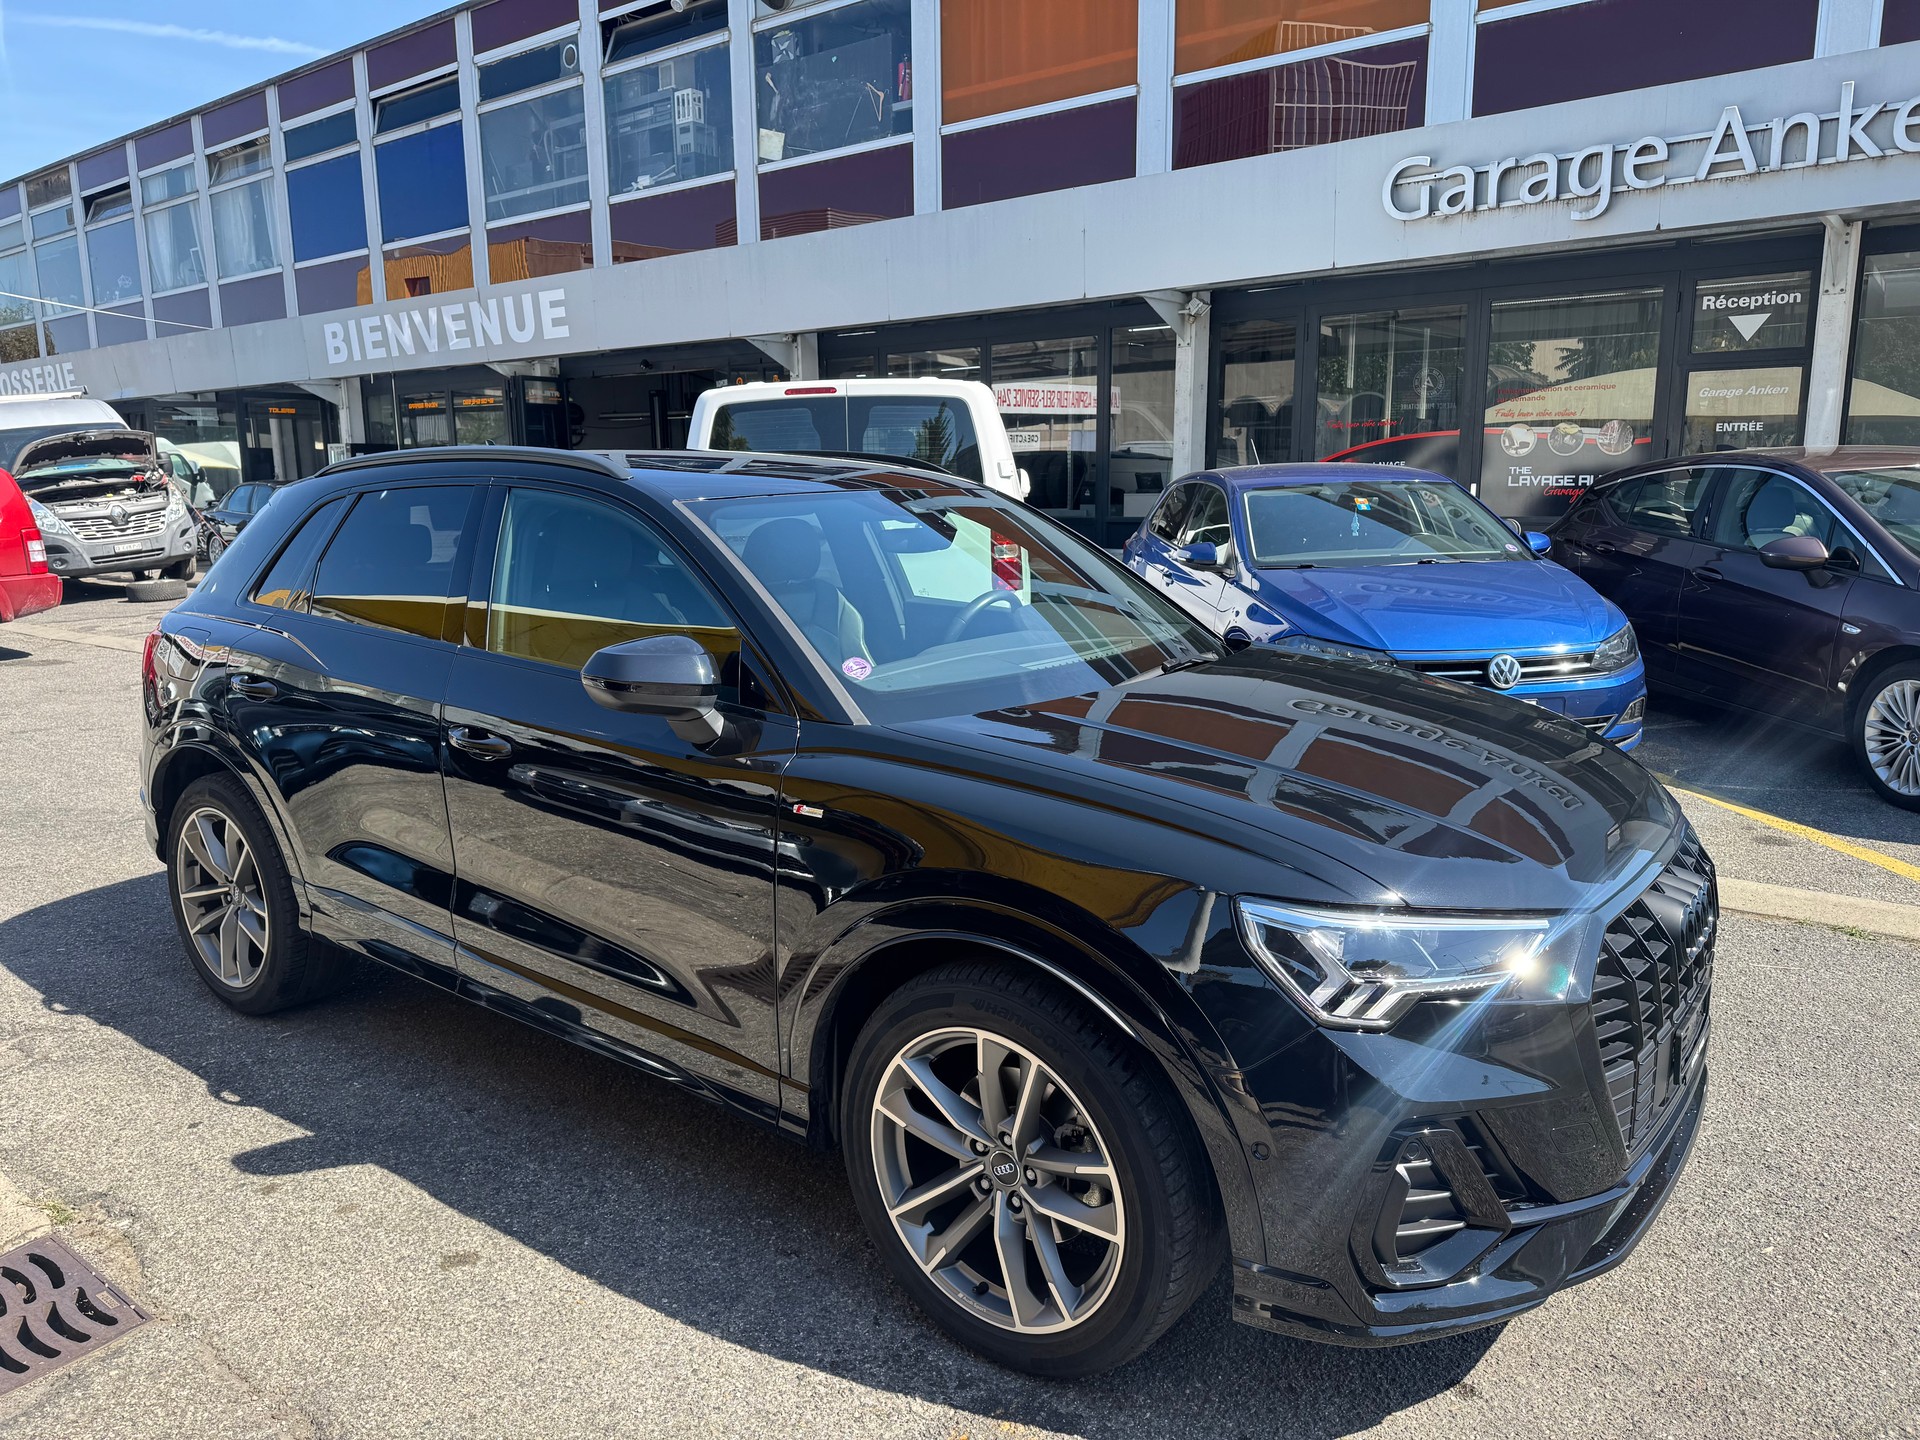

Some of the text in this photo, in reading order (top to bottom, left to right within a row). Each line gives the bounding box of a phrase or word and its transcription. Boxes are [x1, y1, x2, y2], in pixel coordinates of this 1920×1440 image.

[1381, 135, 1669, 221] Garage
[1702, 291, 1802, 310] Réception
[323, 288, 570, 364] BIENVENUE
[1574, 382, 1617, 391] ceramique
[1699, 385, 1789, 398] Garage Anken
[1715, 420, 1764, 432] ENTRÉE
[1508, 466, 1532, 474] THE
[1507, 475, 1576, 486] LAVAGE
